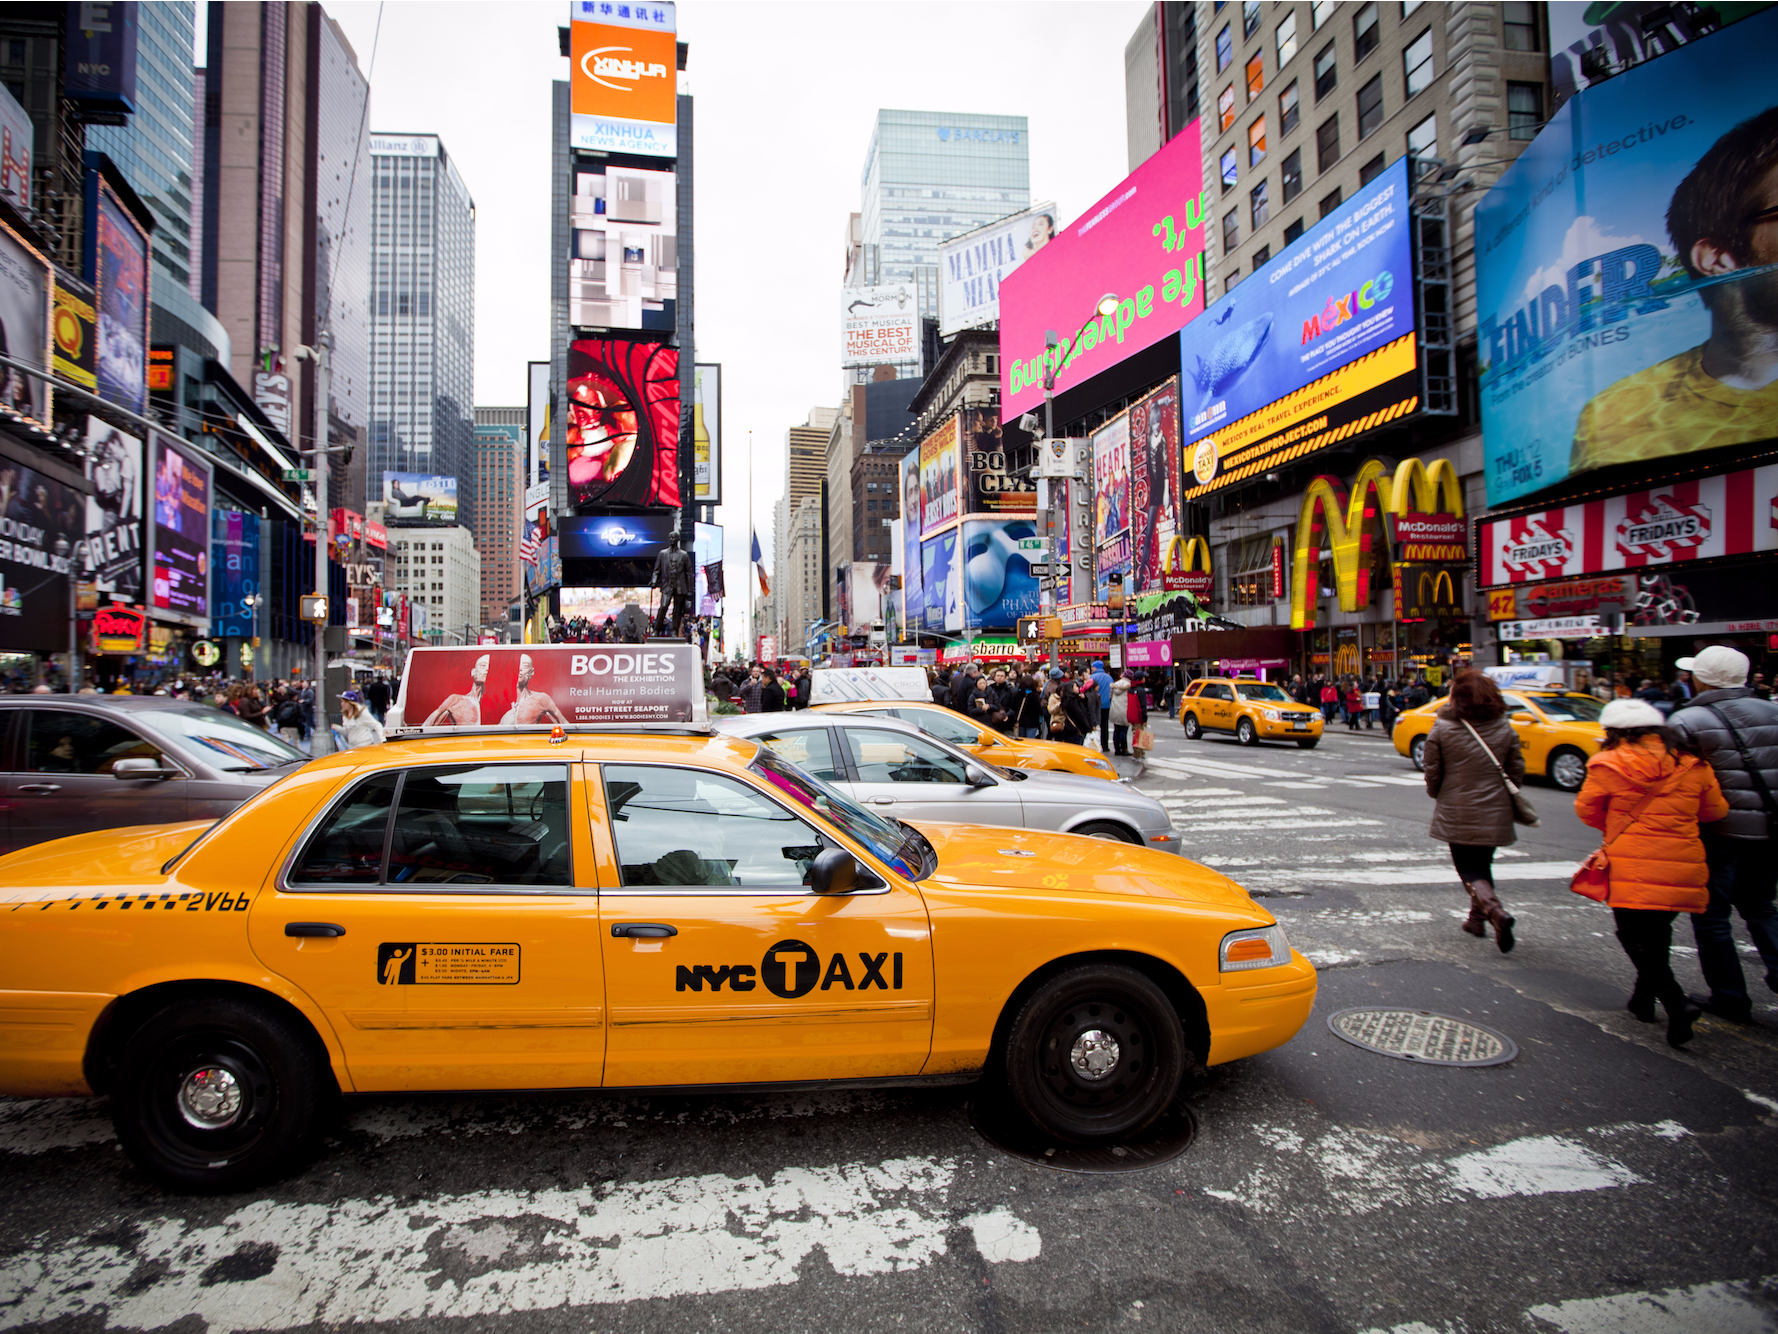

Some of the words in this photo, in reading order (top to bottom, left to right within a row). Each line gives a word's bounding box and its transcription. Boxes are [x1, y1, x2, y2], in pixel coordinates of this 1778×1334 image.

[78, 63, 110, 76] NYC
[594, 56, 666, 80] XINHUA
[594, 122, 655, 140] XINHUA
[954, 128, 1020, 143] BARCLAYS
[581, 135, 615, 146] NEWS
[619, 139, 668, 152] AGENCY
[1493, 203, 1532, 248] different
[1532, 181, 1555, 211] kind
[1555, 165, 1568, 185] of
[1572, 114, 1695, 172] detective.
[1270, 260, 1294, 284] COME
[1293, 247, 1312, 268] DIVE
[1313, 230, 1335, 252] WITH
[1335, 216, 1353, 236] THE
[1353, 184, 1395, 223] BIGGEST
[1314, 240, 1343, 266] SHARK
[1343, 227, 1360, 246] ON
[1361, 203, 1395, 233] EARTH.
[949, 233, 1016, 284] MAMMA
[846, 321, 868, 329] BEST
[872, 319, 912, 328] MUSICAL
[1480, 244, 1671, 391] FINDER
[54, 305, 83, 360] Q
[847, 339, 895, 350] MUSICAL
[897, 337, 913, 346] OF
[877, 327, 912, 338] BEST
[1010, 284, 1154, 396] advertising
[1567, 326, 1631, 360] BONES
[847, 348, 868, 357] THIS
[1222, 428, 1248, 448] MEXICO'S
[1249, 422, 1266, 439] REAL
[1267, 409, 1292, 427] TRAVEL
[1294, 385, 1343, 414] EXPERIENCE.
[1223, 415, 1329, 471] MEXICOTAXIPROJECT.COM
[1096, 442, 1126, 482] HEART
[1198, 455, 1213, 468] TAXI
[291, 470, 299, 479] 46
[1512, 464, 1532, 487] FOX
[1534, 459, 1543, 478] 5
[925, 496, 943, 527] JERSEY
[1398, 521, 1466, 532] McDonald's
[1026, 541, 1034, 549] 46
[13, 543, 50, 571] BOWL
[342, 563, 376, 585] EY'S
[1002, 599, 1039, 610] PHAN
[761, 637, 774, 663] tkts
[972, 640, 1015, 655] sbarro
[571, 653, 675, 675] BODIES
[569, 687, 592, 696] Real
[596, 686, 635, 696] Human
[640, 686, 675, 695] Bodies
[421, 948, 448, 956] $3.00
[451, 948, 485, 956] INITIAL
[490, 948, 514, 956] FARE
[676, 965, 756, 991] NYC
[768, 945, 902, 994] TAXI
